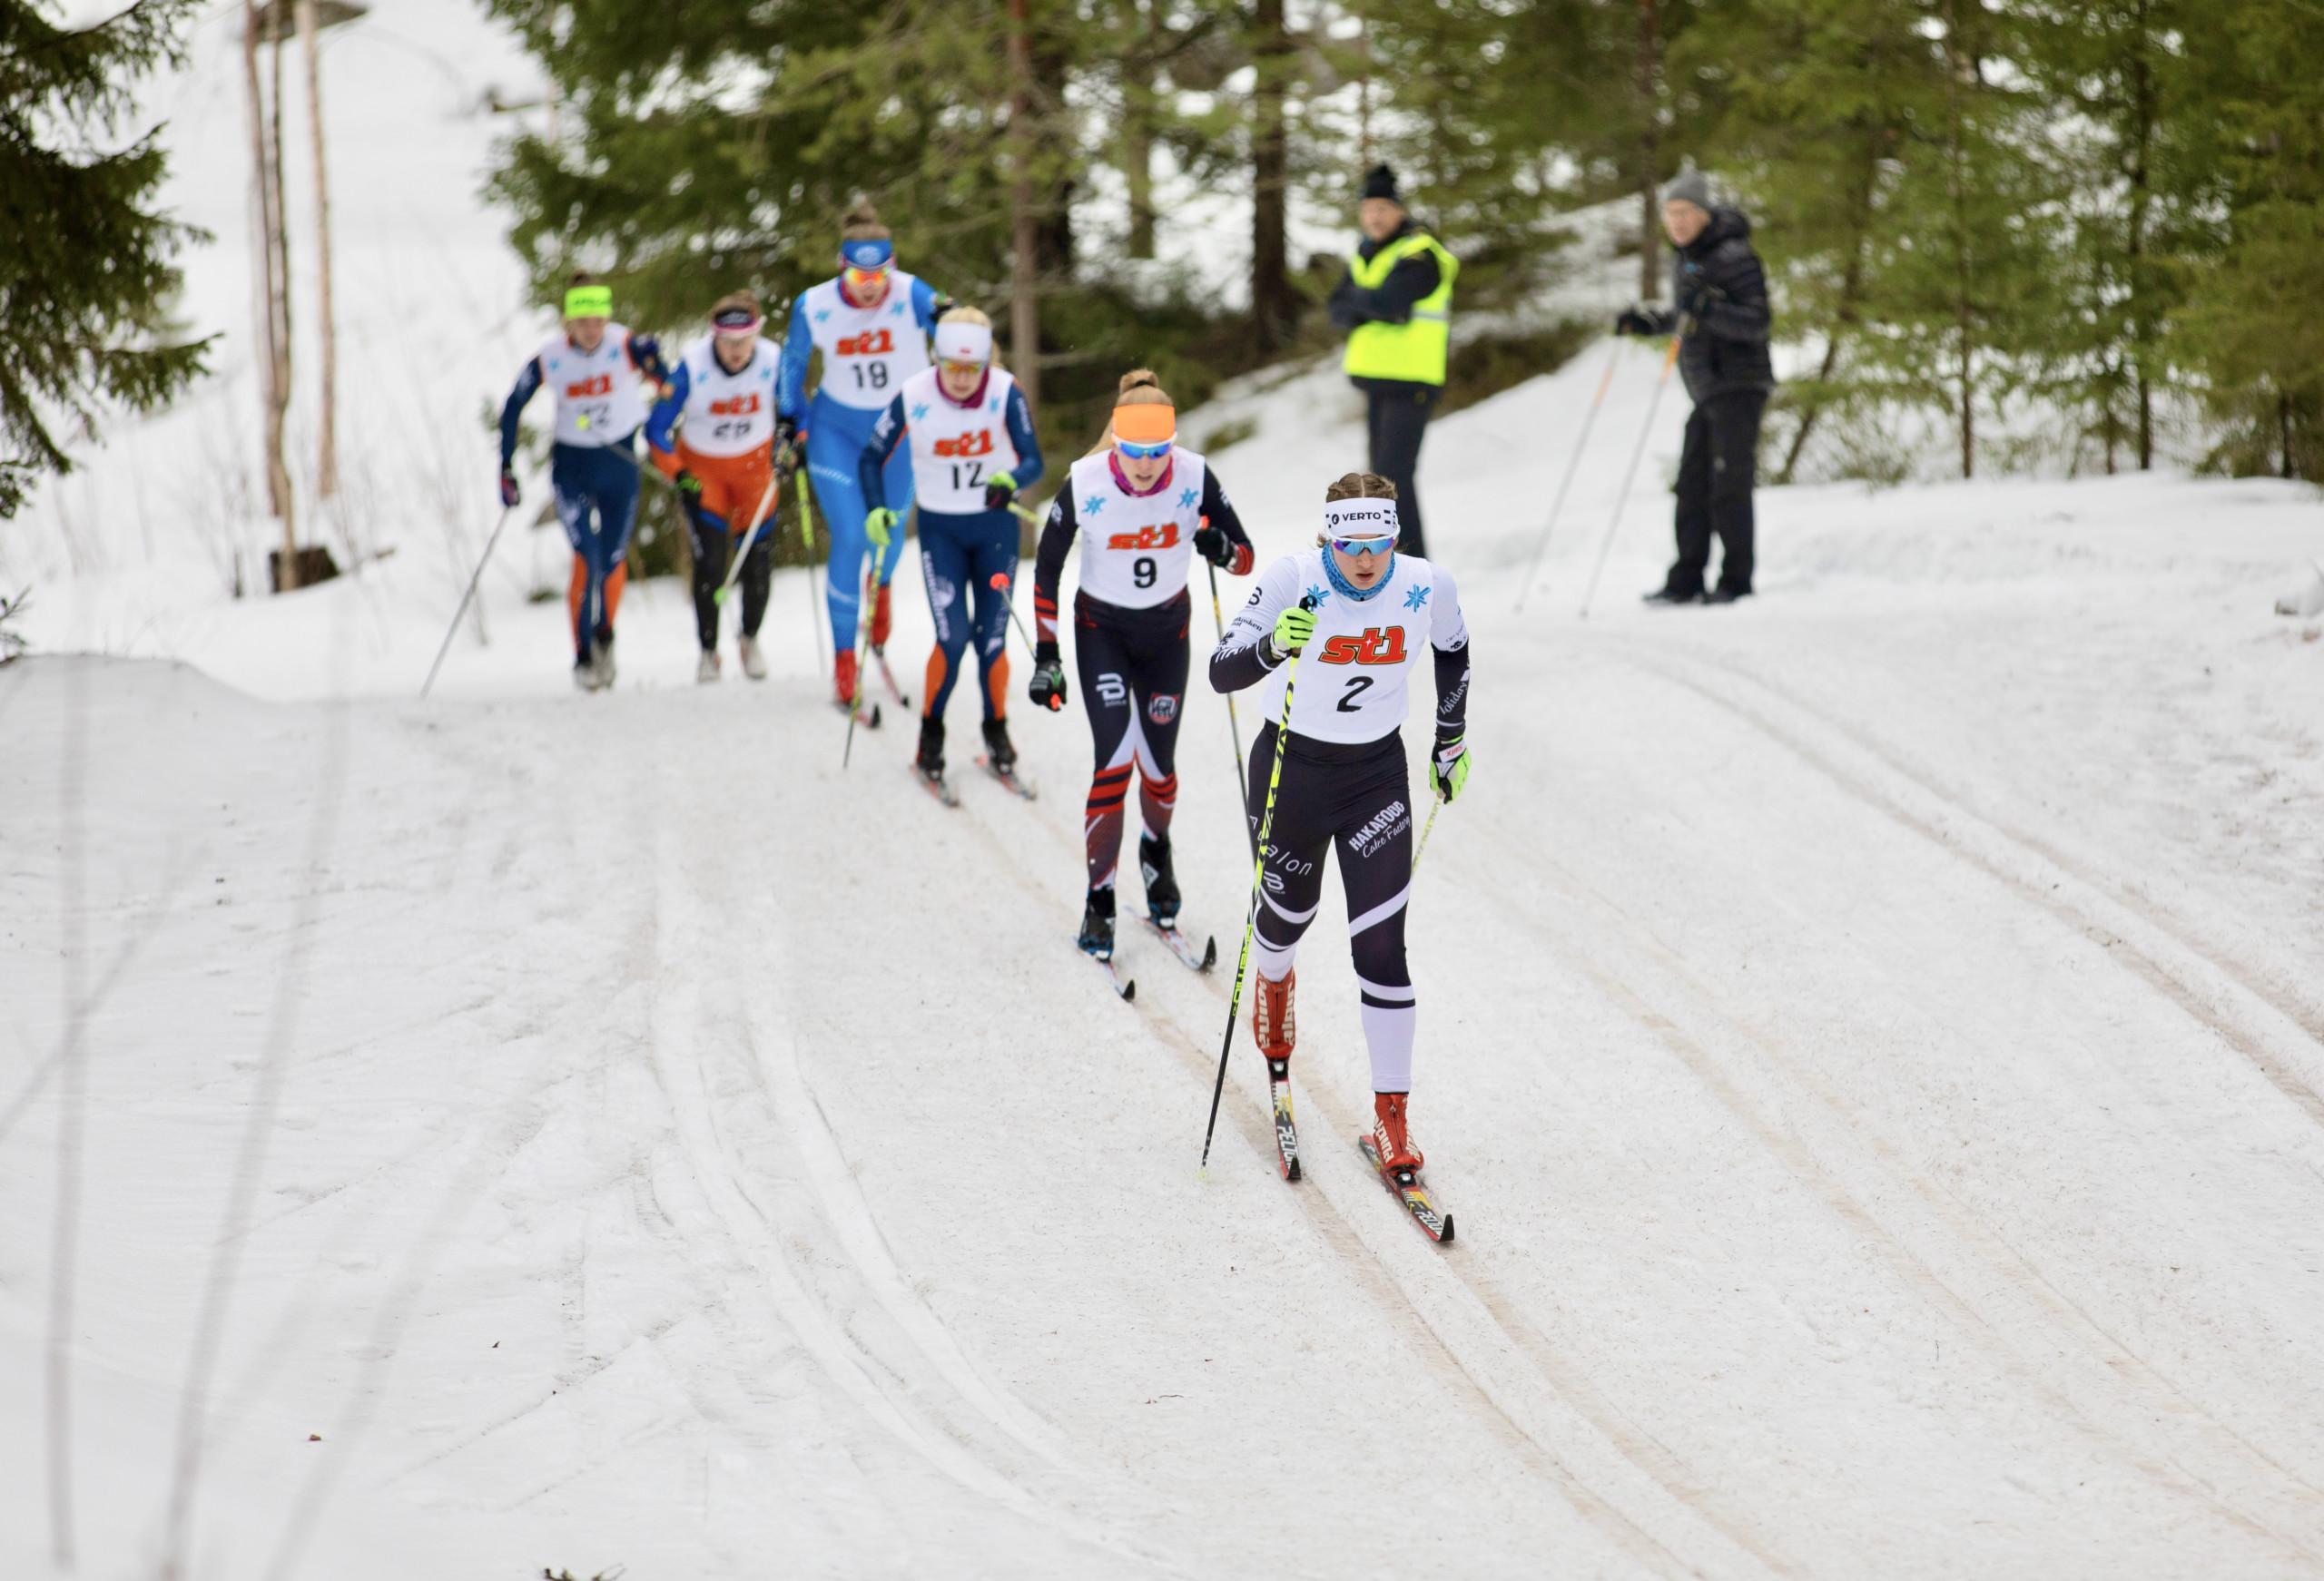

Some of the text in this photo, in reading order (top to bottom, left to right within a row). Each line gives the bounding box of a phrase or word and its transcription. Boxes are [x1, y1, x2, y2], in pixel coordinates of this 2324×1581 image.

[836, 329, 894, 357] st1
[932, 428, 993, 457] st1
[951, 460, 987, 490] 12
[1342, 511, 1382, 522] VERTO
[1107, 522, 1180, 550] st1
[1133, 556, 1157, 588] 9
[1317, 625, 1407, 665] st1
[1336, 675, 1374, 712] 2
[1348, 800, 1405, 851] HAKAFOOD
[1363, 837, 1387, 859] Cake
